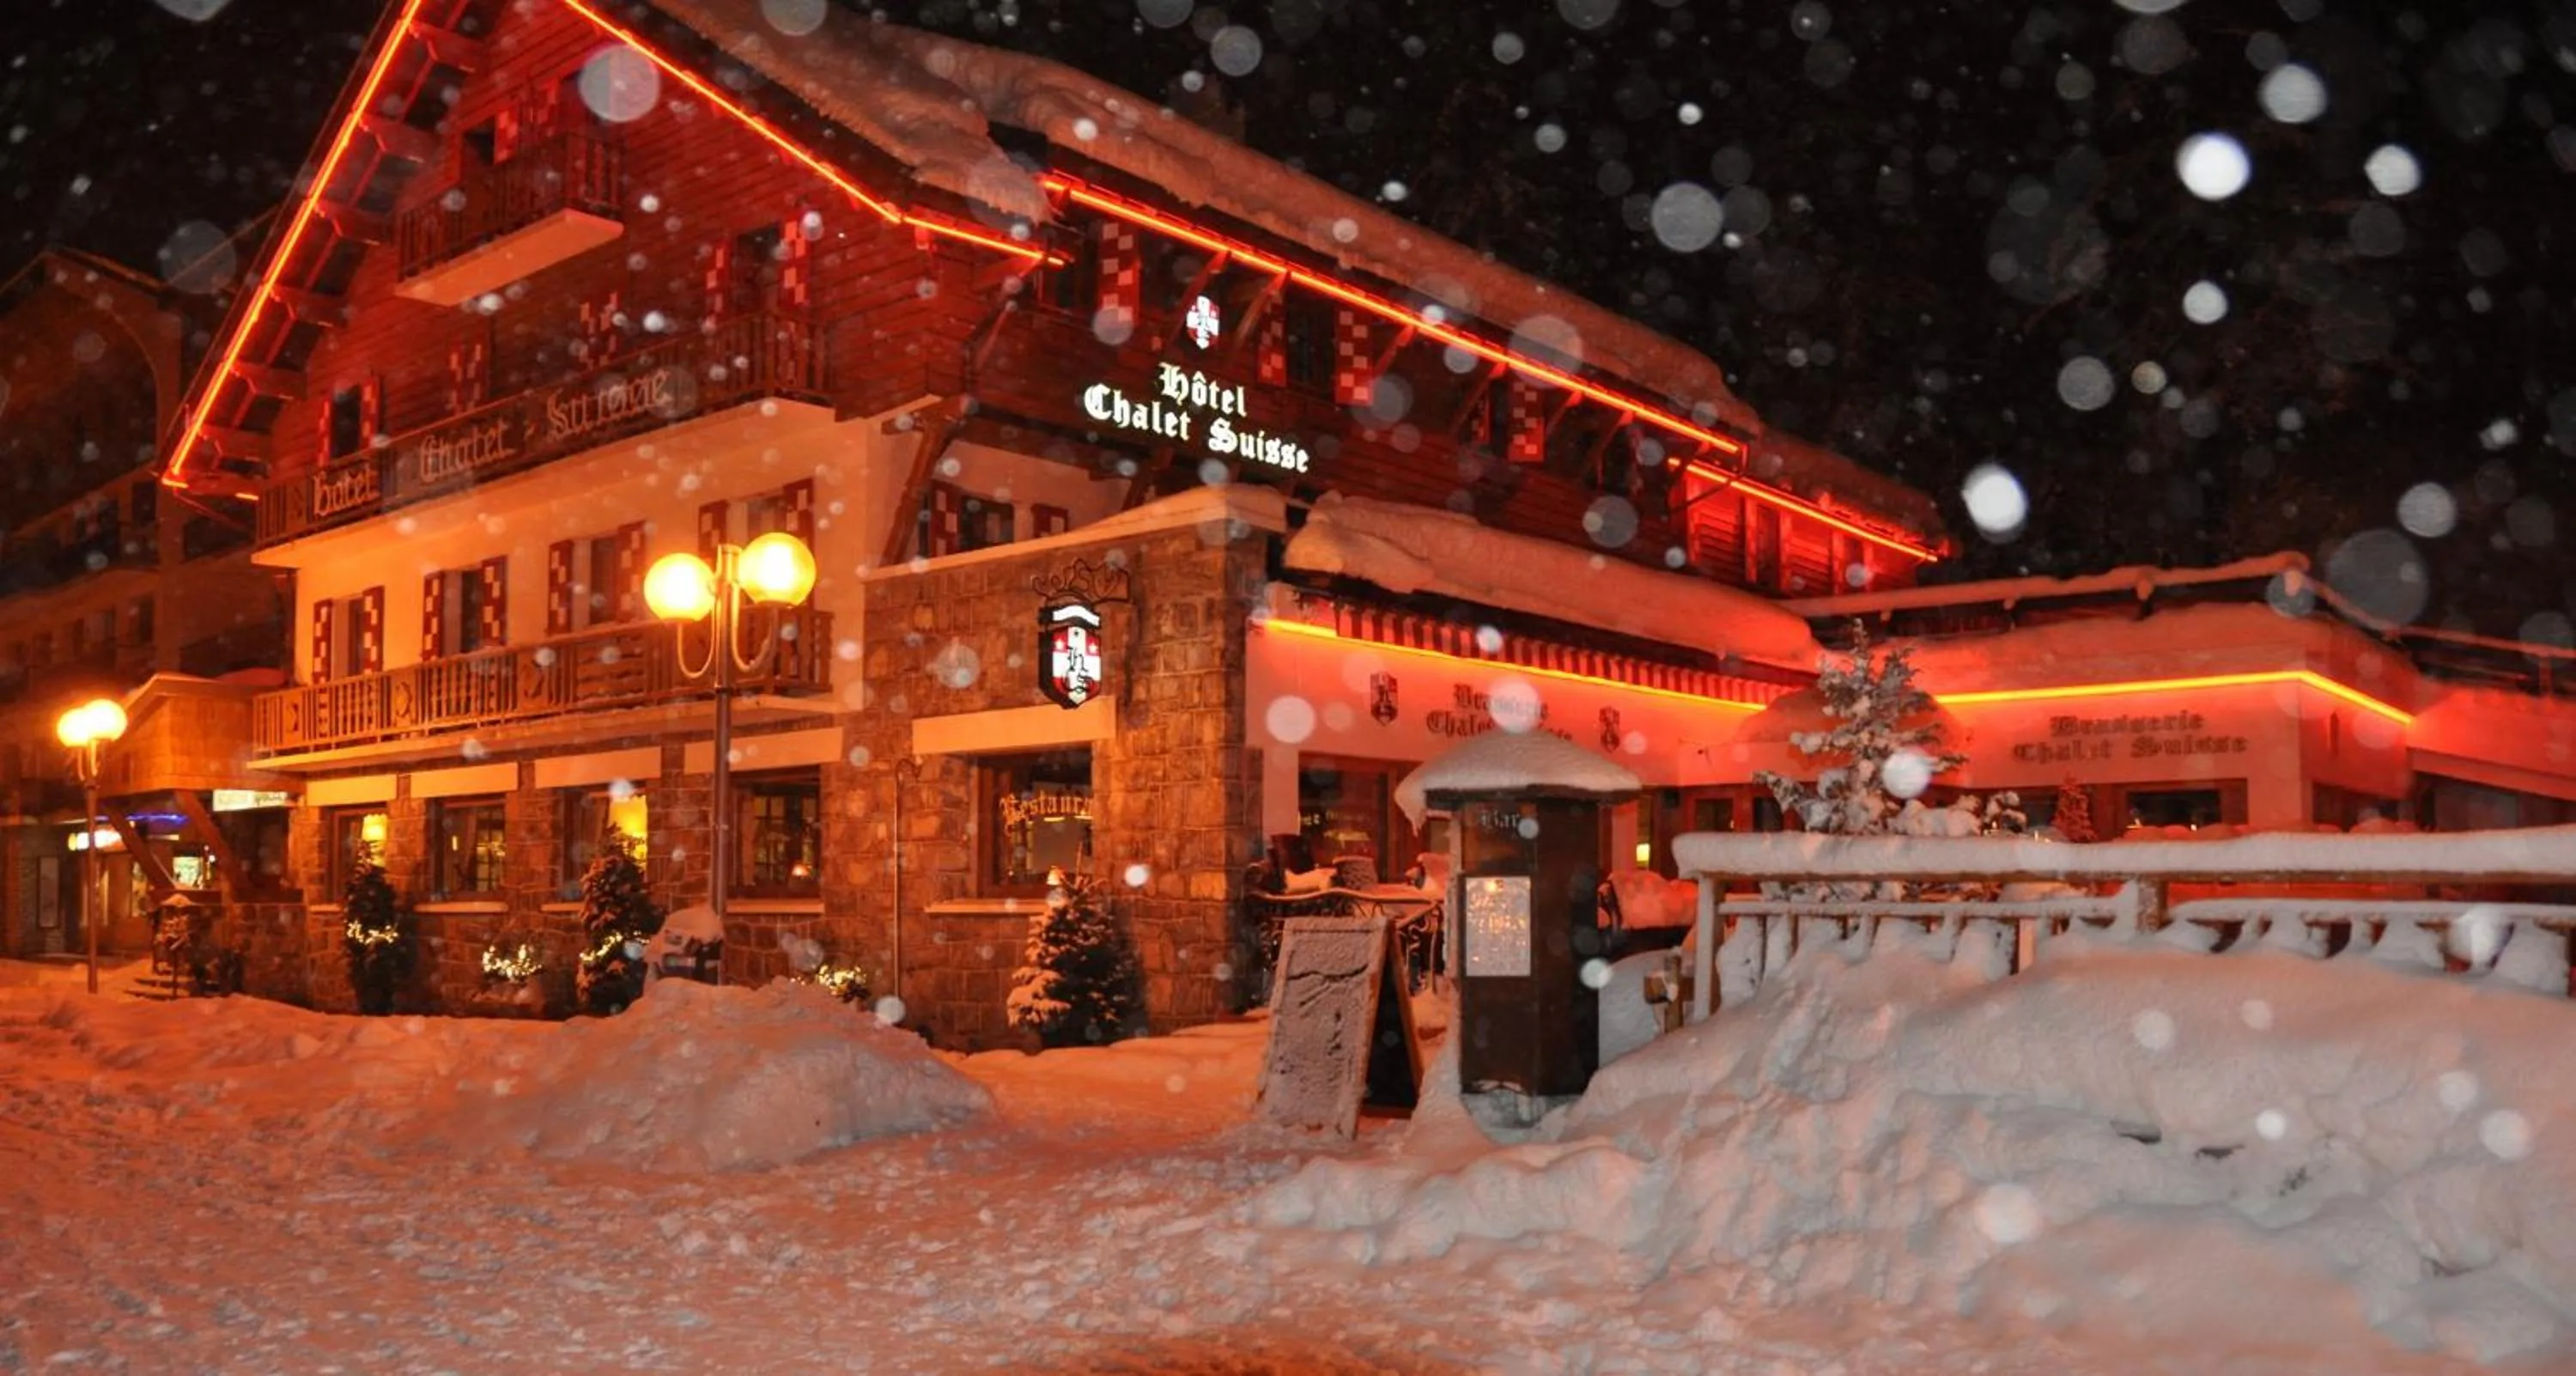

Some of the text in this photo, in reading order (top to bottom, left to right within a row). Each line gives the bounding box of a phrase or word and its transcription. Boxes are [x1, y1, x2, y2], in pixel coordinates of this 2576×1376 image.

[1159, 362, 1247, 417] Hôtel
[1084, 383, 1309, 473] Chalet Suisse
